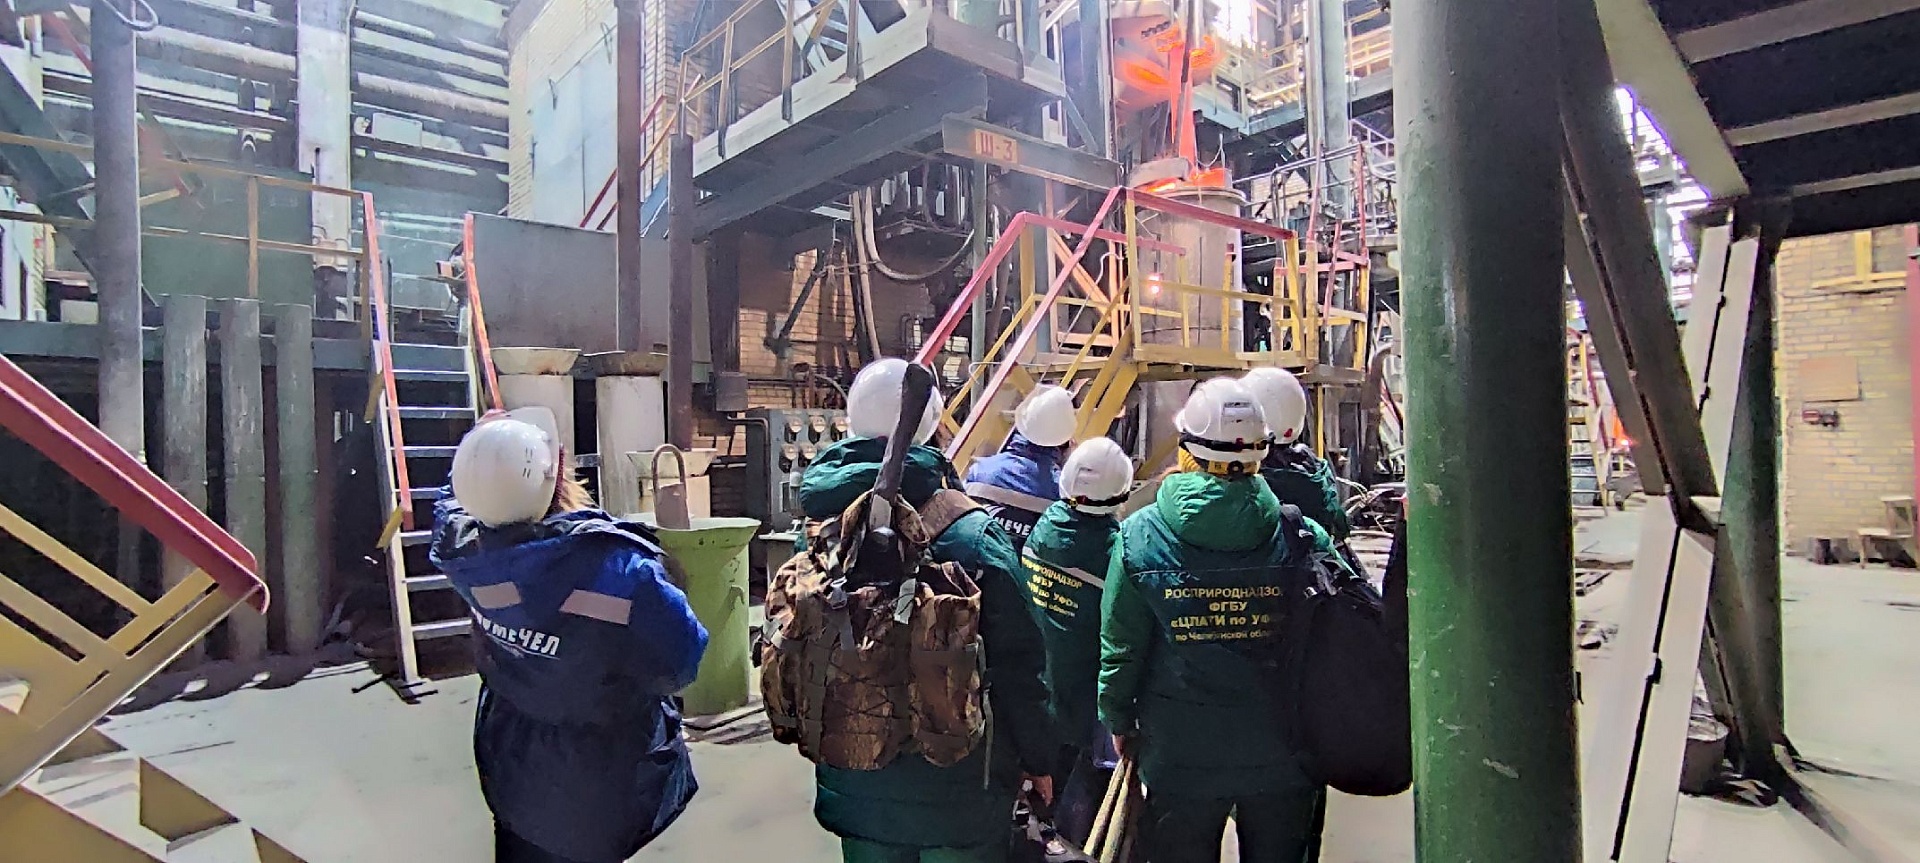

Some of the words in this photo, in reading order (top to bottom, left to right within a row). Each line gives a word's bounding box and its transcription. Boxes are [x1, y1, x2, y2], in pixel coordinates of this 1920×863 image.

[980, 132, 1013, 161] Ш-3
[1164, 586, 1283, 599] РОСПРИРОДНАДЗО
[1208, 601, 1248, 612] ФГБУ
[1229, 616, 1247, 627] по
